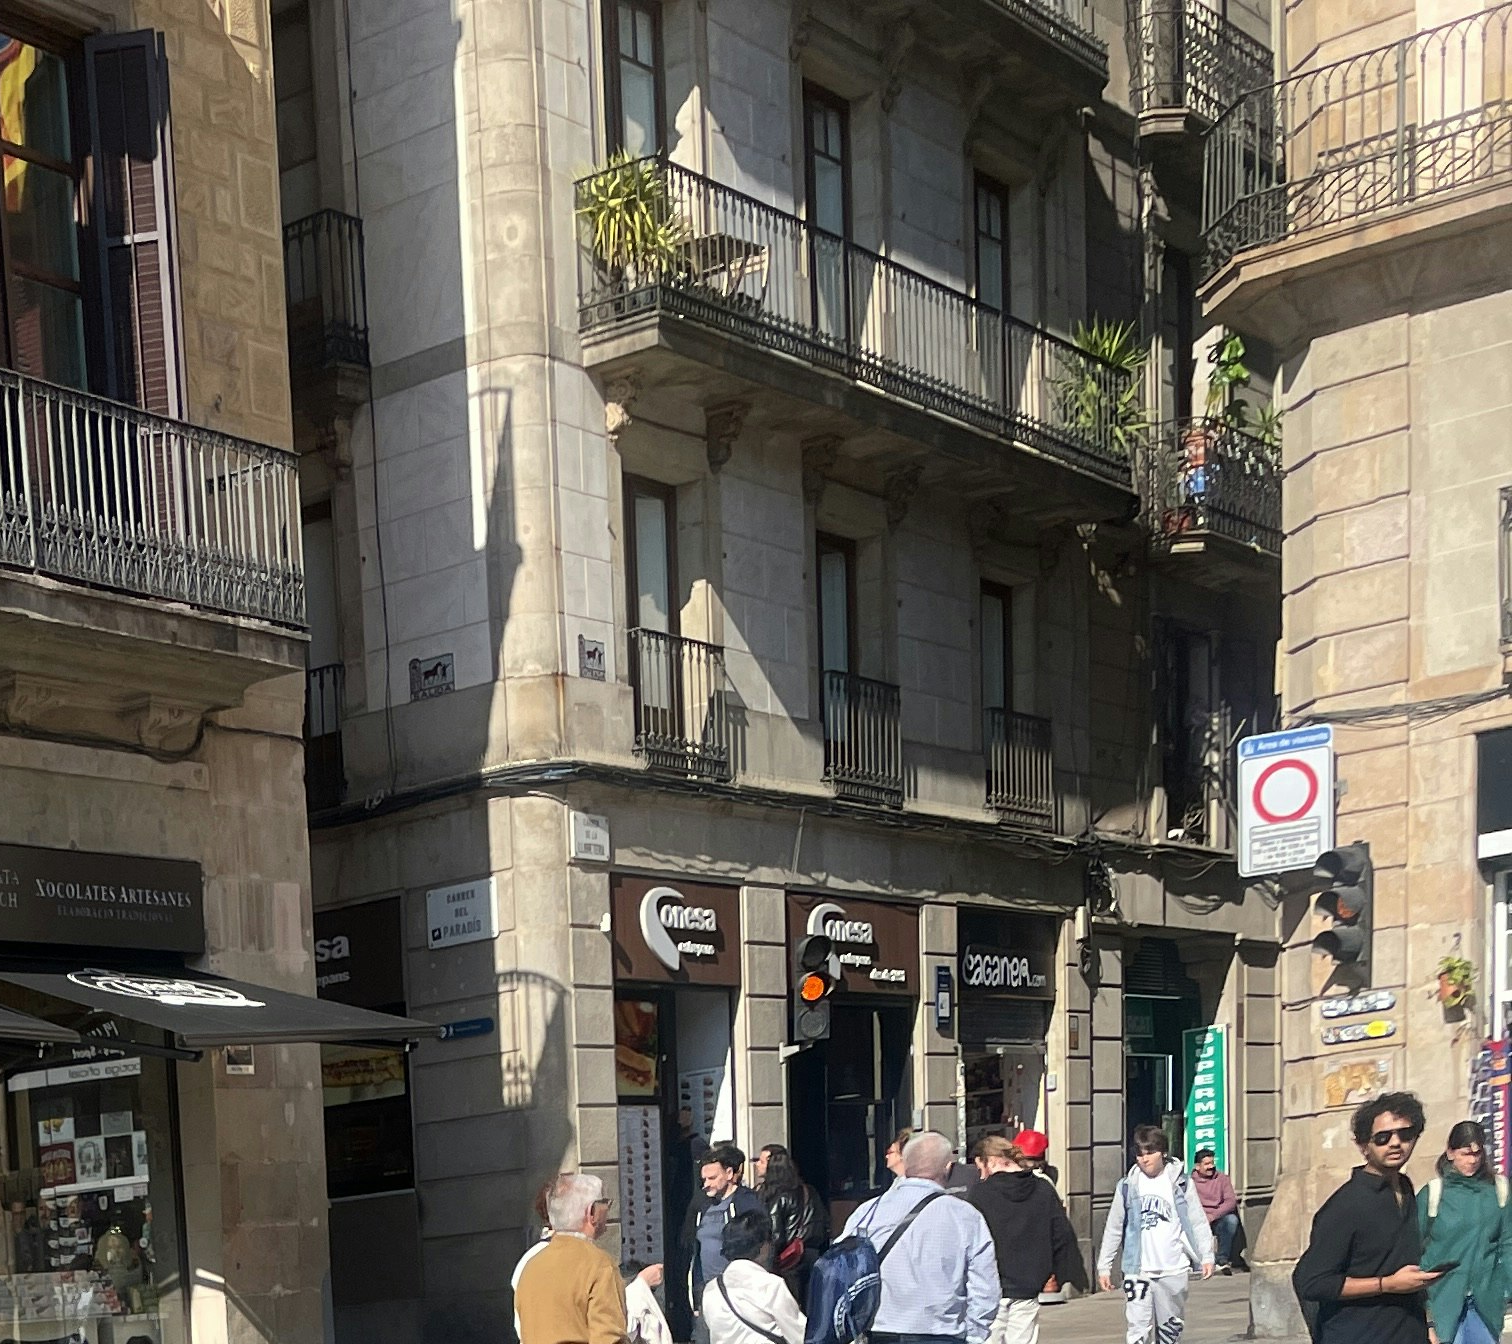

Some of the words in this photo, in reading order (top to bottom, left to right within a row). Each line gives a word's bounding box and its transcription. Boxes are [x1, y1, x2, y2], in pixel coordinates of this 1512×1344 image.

[36, 878, 116, 902] XOCOLATES
[118, 885, 192, 908] ARTESANES
[443, 915, 481, 938] PARADÍS
[640, 886, 717, 971] Conesa
[1194, 1033, 1219, 1158] SUPERMERC
[1123, 1279, 1150, 1302] 87
